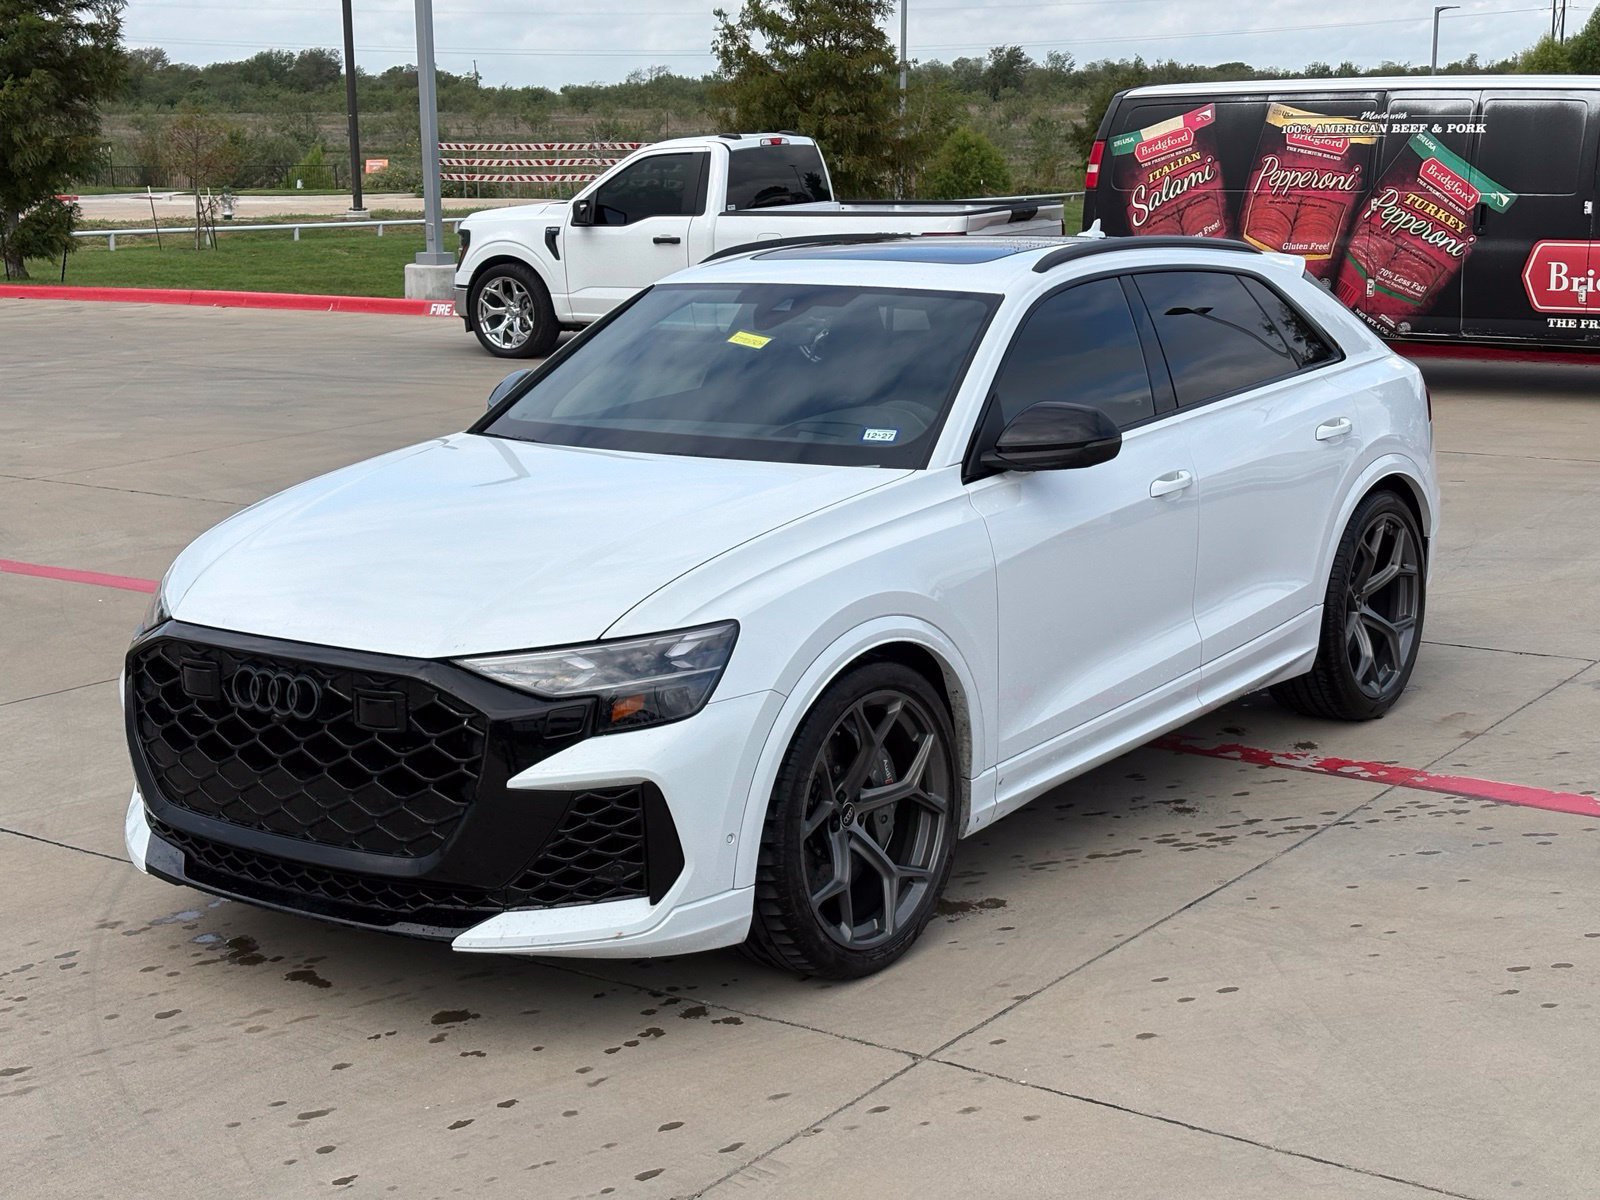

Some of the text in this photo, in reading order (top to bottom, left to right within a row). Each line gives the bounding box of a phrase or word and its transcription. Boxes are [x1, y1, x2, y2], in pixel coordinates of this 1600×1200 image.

[1360, 111, 1408, 120] Made with
[1281, 123, 1487, 134] 100% AMERICAN BEEF & PORK
[1141, 131, 1189, 156] Bridgford
[1151, 153, 1175, 164] PREMIUM
[1175, 147, 1193, 156] BRAND
[1297, 147, 1322, 157] PREMIUM
[1323, 153, 1341, 161] BRAND
[1425, 137, 1437, 152] USA
[1148, 151, 1201, 183] ITALIAN
[1253, 156, 1360, 196] Pepperoni
[1132, 157, 1214, 227] Salami
[1426, 164, 1475, 203] Bridgford
[1417, 177, 1466, 216] THE PREMIUM BRAND
[1364, 188, 1474, 256] Pepperoni
[1403, 193, 1467, 233] TURKEY
[1203, 219, 1221, 235] Free!
[1309, 242, 1330, 250] Free!
[1379, 267, 1427, 293] 70% Less Fat!
[1546, 261, 1600, 292] Bri
[430, 303, 452, 316] FIRE
[1547, 318, 1600, 329] THE PR
